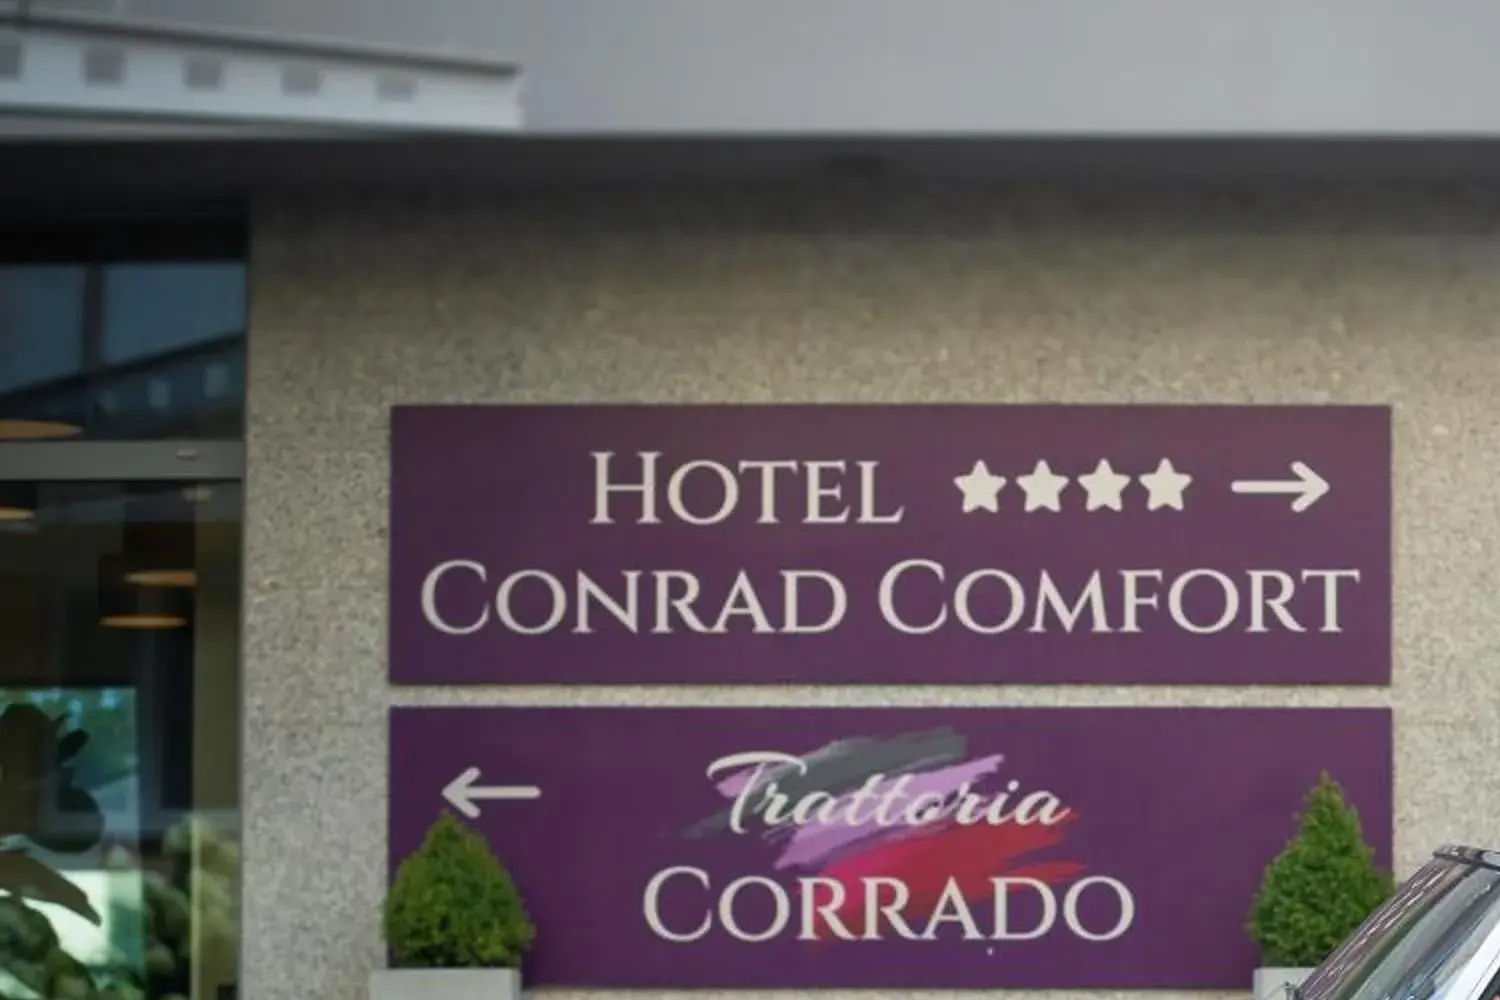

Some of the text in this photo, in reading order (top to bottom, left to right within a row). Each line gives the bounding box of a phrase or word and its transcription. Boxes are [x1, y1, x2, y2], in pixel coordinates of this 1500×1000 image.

[589, 451, 904, 525] HOTEL
[420, 558, 1361, 635] CONRAD COMFORT
[705, 750, 1071, 835] Trattoria
[642, 865, 1135, 943] CORRADO
